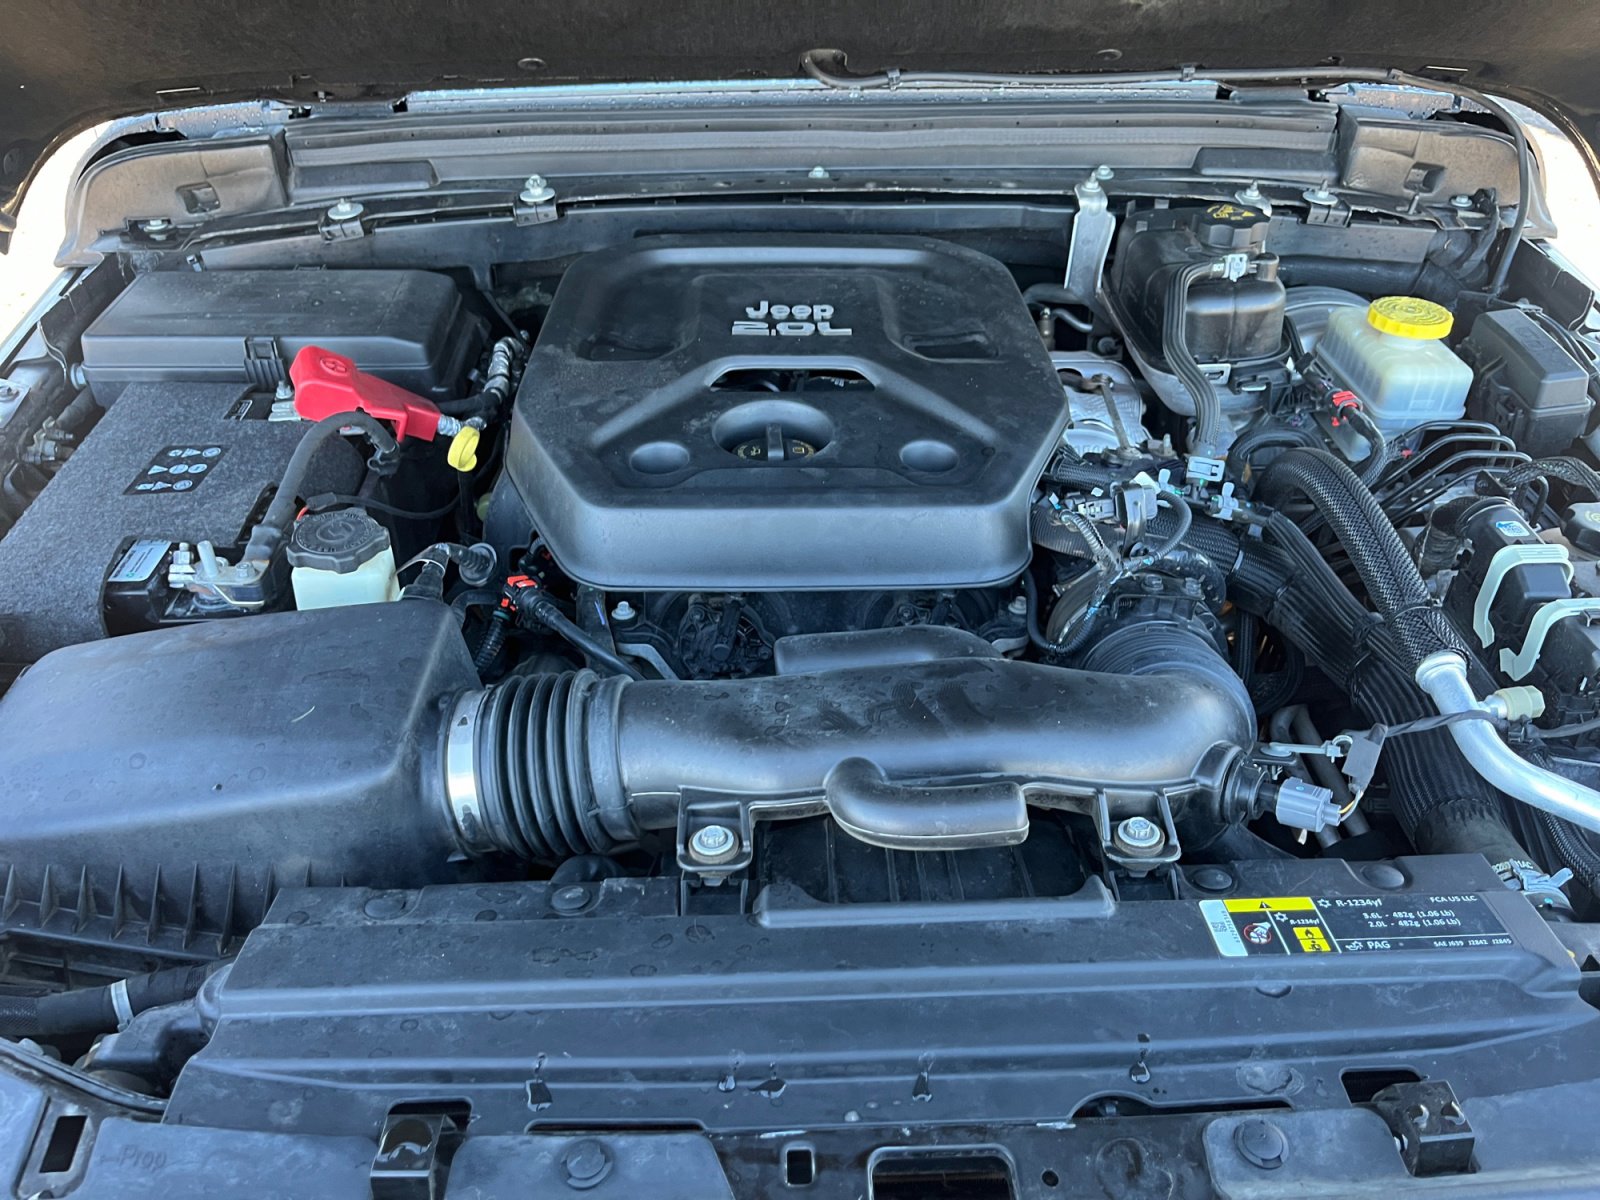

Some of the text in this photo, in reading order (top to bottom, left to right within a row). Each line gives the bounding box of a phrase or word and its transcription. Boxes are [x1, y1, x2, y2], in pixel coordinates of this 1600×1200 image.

[745, 300, 834, 321] Jeep
[731, 321, 853, 337] 2.0L
[1367, 940, 1391, 949] PAG
